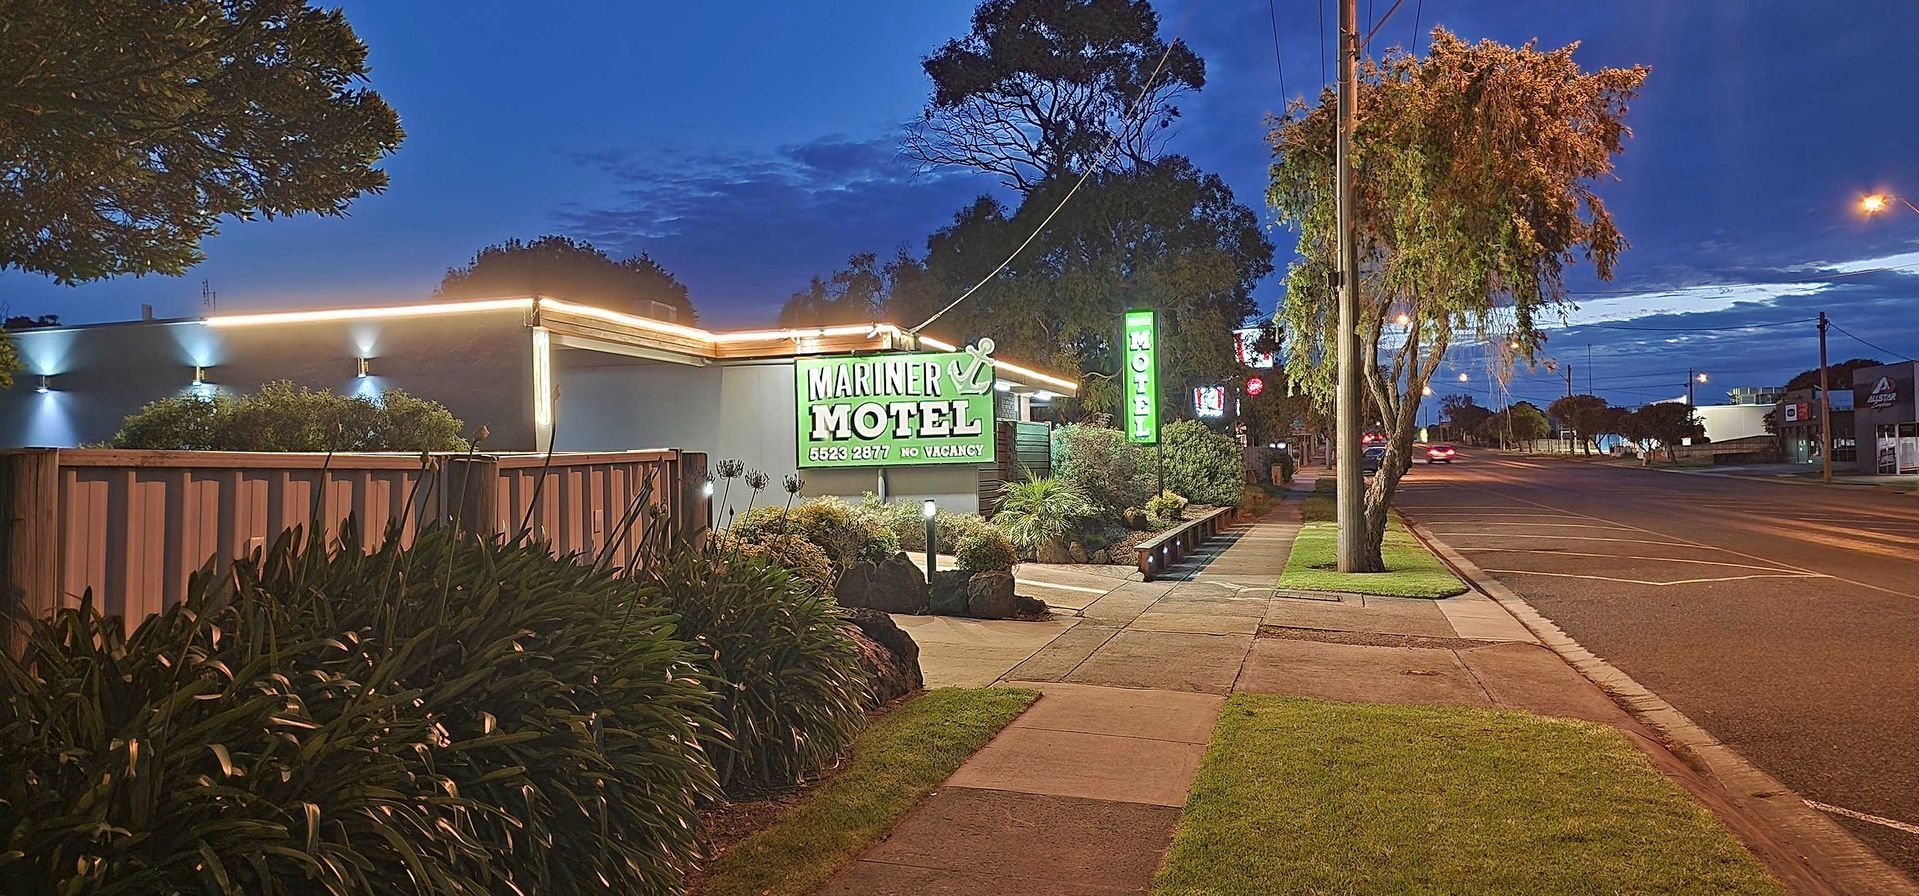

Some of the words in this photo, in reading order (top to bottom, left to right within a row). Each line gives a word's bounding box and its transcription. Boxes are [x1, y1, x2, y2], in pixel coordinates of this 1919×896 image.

[809, 361, 942, 401] MARINER
[1129, 331, 1151, 438] MOTEL
[1867, 392, 1896, 403] ALLSTAR
[809, 400, 982, 441] MOTEL
[809, 446, 848, 461] 5523
[852, 445, 890, 460] 2877
[900, 447, 920, 458] NO
[924, 444, 984, 458] VACANCY
